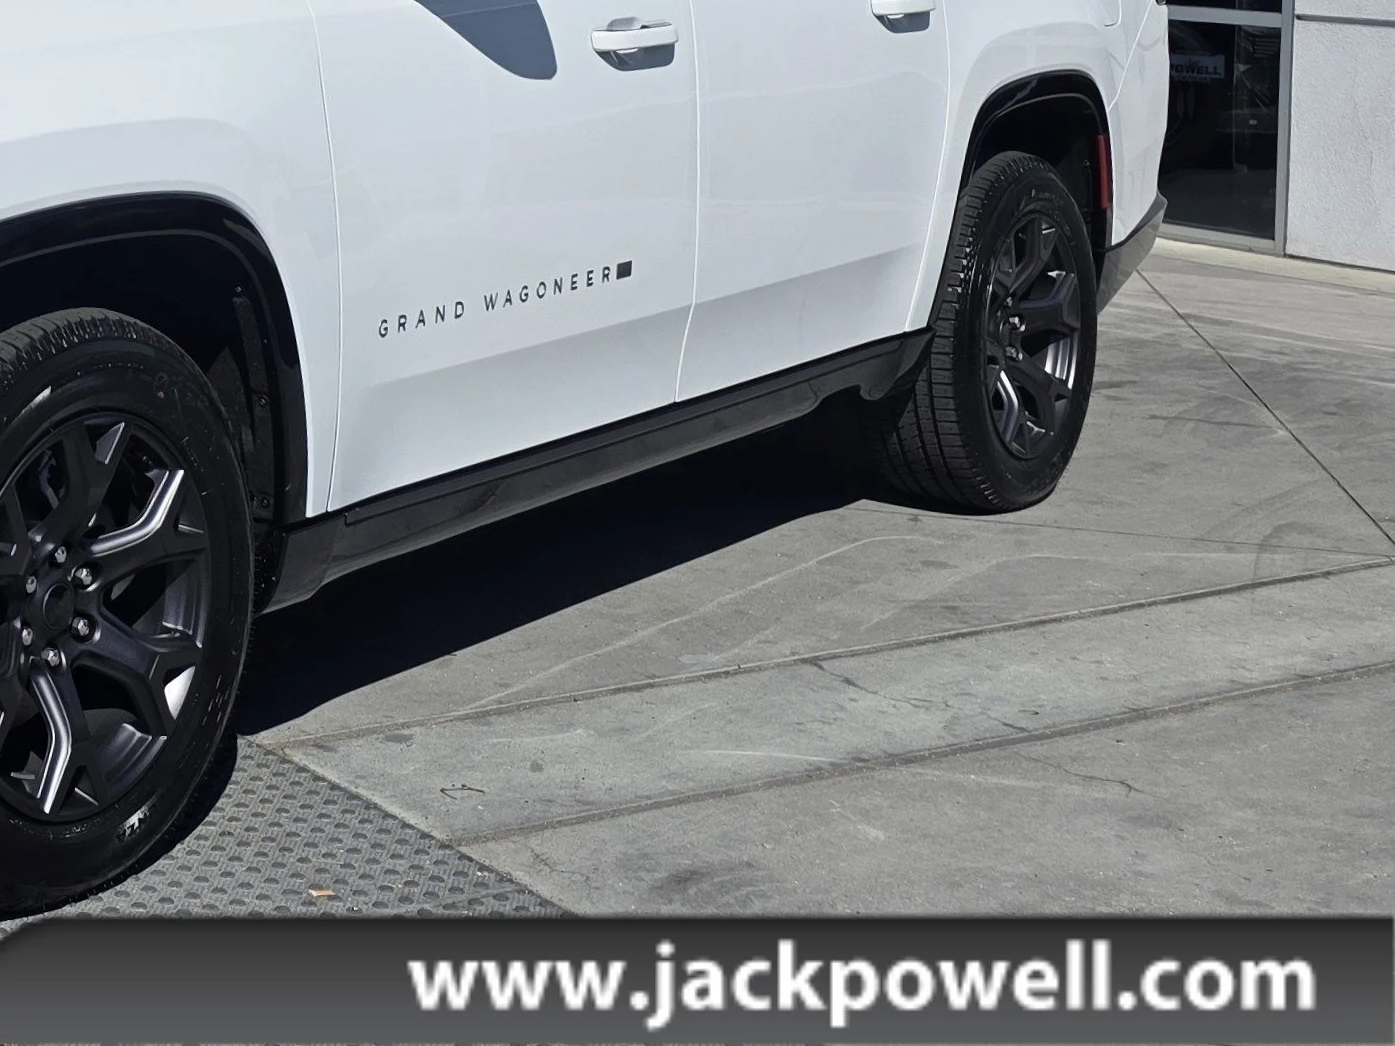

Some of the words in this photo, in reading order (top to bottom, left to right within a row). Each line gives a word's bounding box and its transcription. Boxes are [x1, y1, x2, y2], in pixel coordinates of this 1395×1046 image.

[1170, 63, 1223, 76] OWELL
[378, 301, 465, 338] GRAND
[483, 266, 611, 312] WAGONEER
